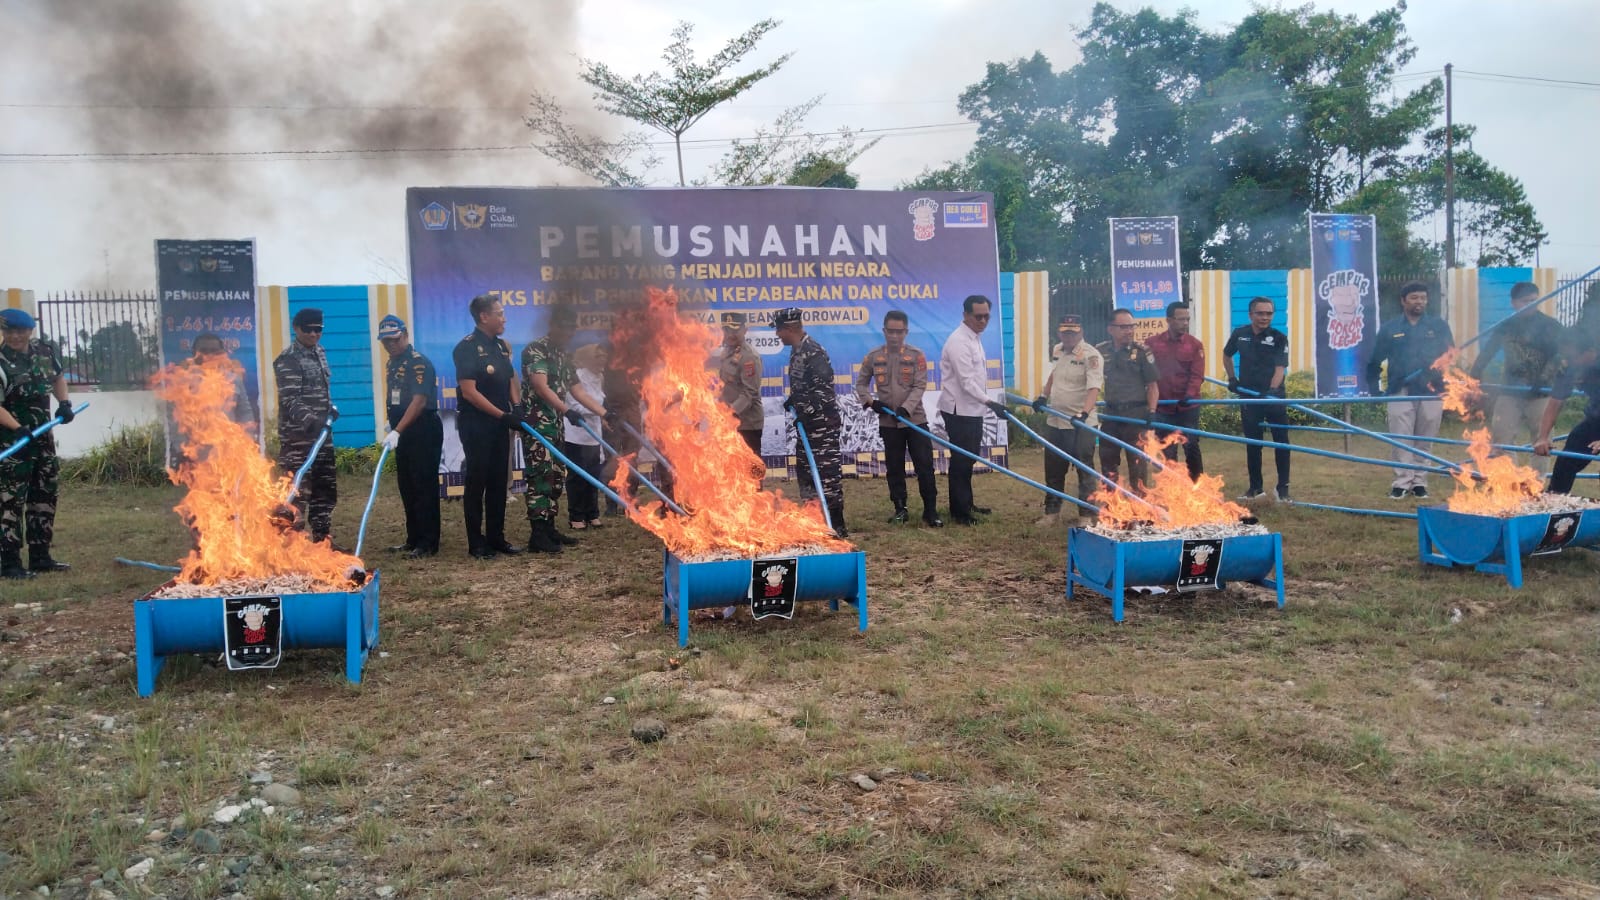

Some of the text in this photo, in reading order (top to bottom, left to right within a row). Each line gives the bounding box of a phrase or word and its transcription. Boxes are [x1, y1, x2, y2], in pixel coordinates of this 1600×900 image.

[540, 224, 888, 259] PEMUSNAHAN
[625, 264, 676, 281] YANG
[681, 262, 761, 280] MENJADI
[766, 262, 816, 279] MILIK
[820, 261, 891, 278] NEGARA
[1117, 259, 1174, 269] PEMUSNAHAN
[722, 285, 846, 303] KEPABEANAN
[848, 285, 884, 301] DAN
[887, 283, 939, 300] CUKAI
[1320, 271, 1369, 298] GEMPUR
[164, 290, 250, 301] PEMUSNAHAN
[1133, 299, 1164, 311] LITER
[800, 310, 863, 322] OROWALI
[1329, 317, 1363, 336] ROKOK
[755, 337, 780, 348] 2025
[1330, 331, 1361, 348] ILEGAL
